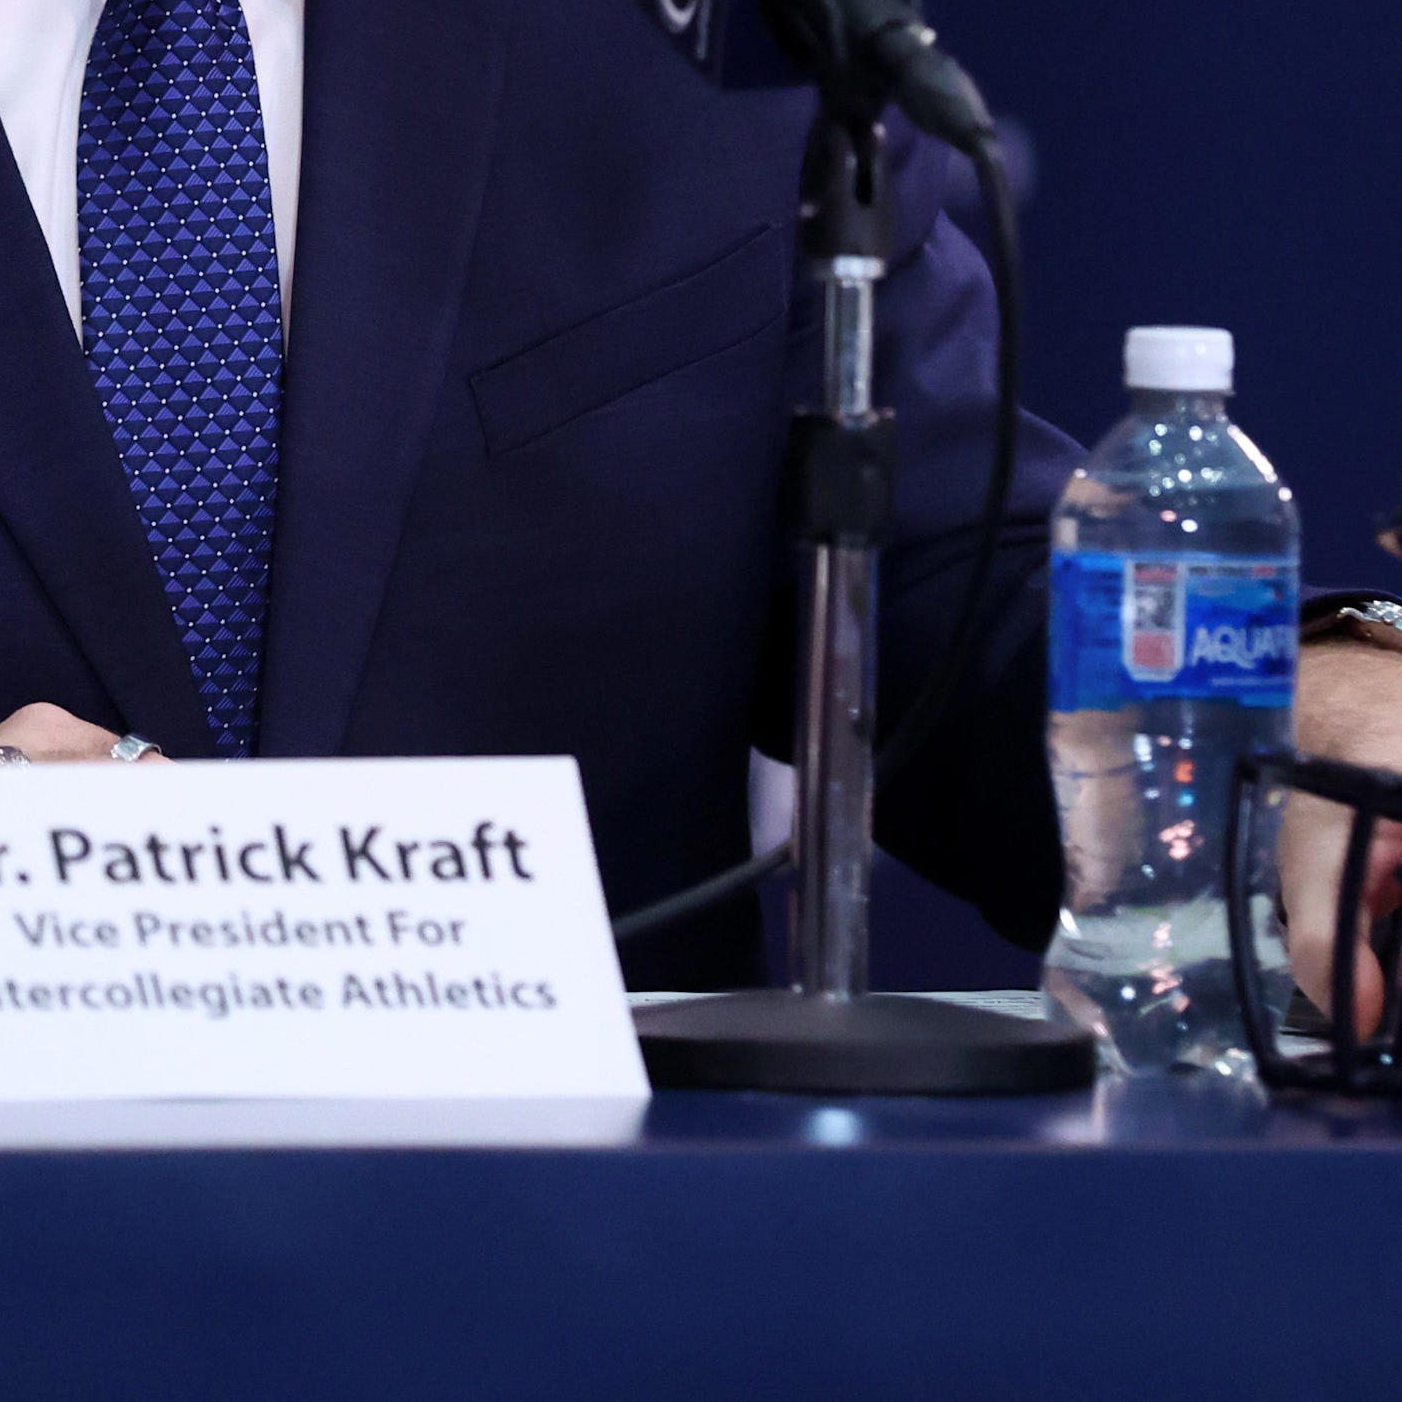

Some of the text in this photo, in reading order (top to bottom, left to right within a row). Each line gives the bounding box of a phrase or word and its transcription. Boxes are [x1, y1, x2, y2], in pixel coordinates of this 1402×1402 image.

[48, 822, 321, 885] Patrick
[339, 819, 534, 883] Kraft
[13, 908, 466, 949] Vice President For
[341, 971, 558, 1010] Athletics
